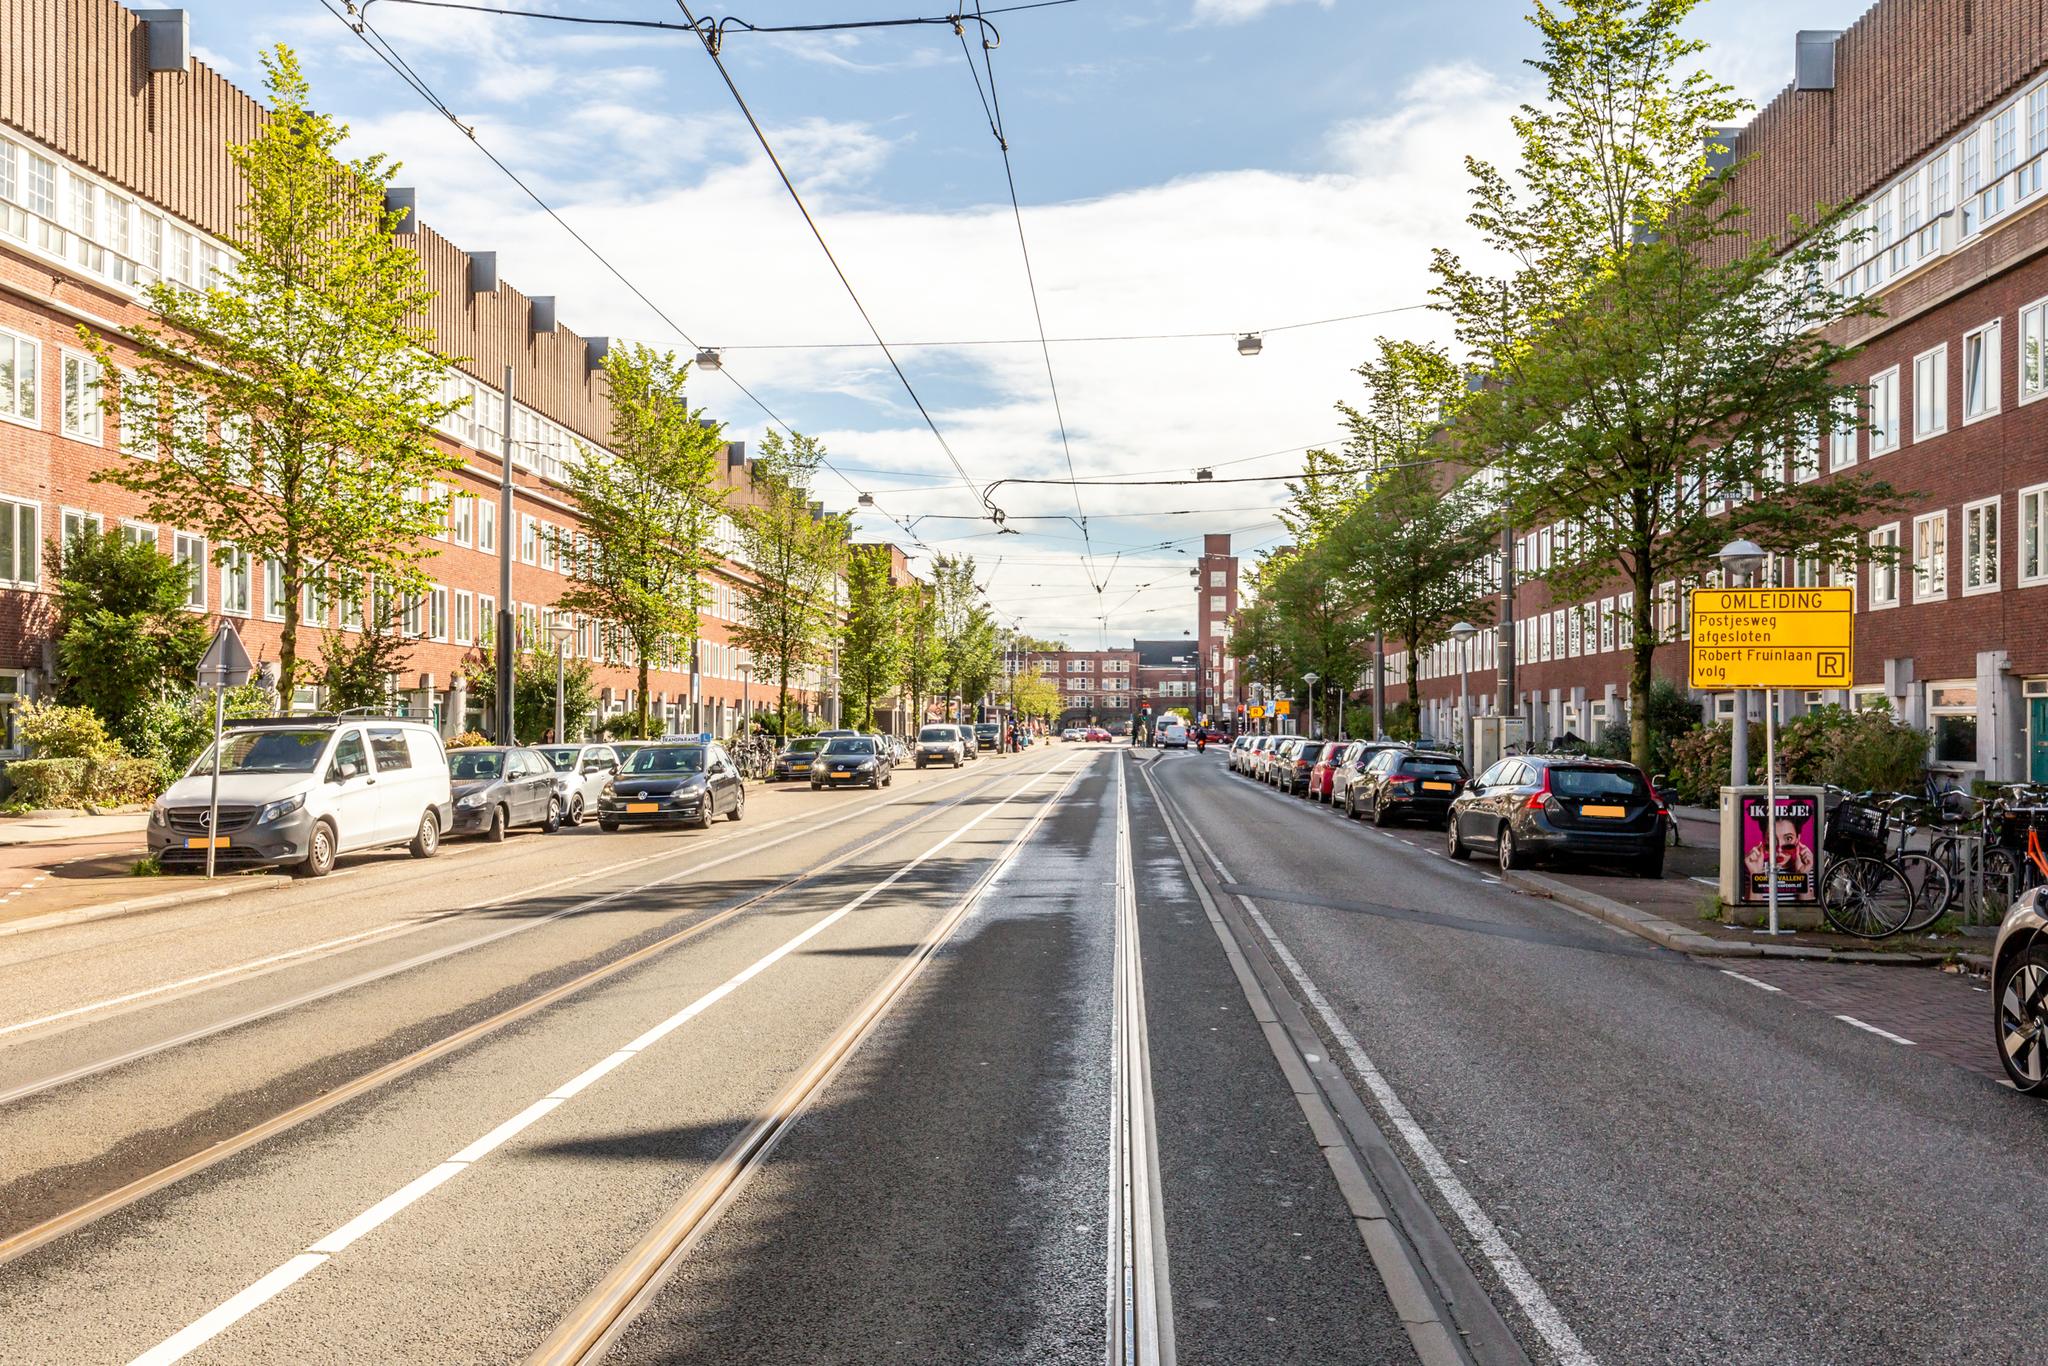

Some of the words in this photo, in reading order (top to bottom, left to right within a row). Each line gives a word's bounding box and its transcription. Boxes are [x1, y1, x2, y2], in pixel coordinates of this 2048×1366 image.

[1721, 593, 1823, 609] OMLEIDING
[1699, 615, 1776, 630] Postjesweg
[1698, 631, 1771, 645] afgesloten
[1699, 649, 1742, 661] Robert
[1747, 649, 1812, 661] Fruinlaan
[1698, 665, 1726, 680] volg
[1824, 656, 1837, 674] R
[1750, 805, 1765, 816] IK
[1767, 805, 1788, 816] IE
[1789, 805, 1809, 816] JE!
